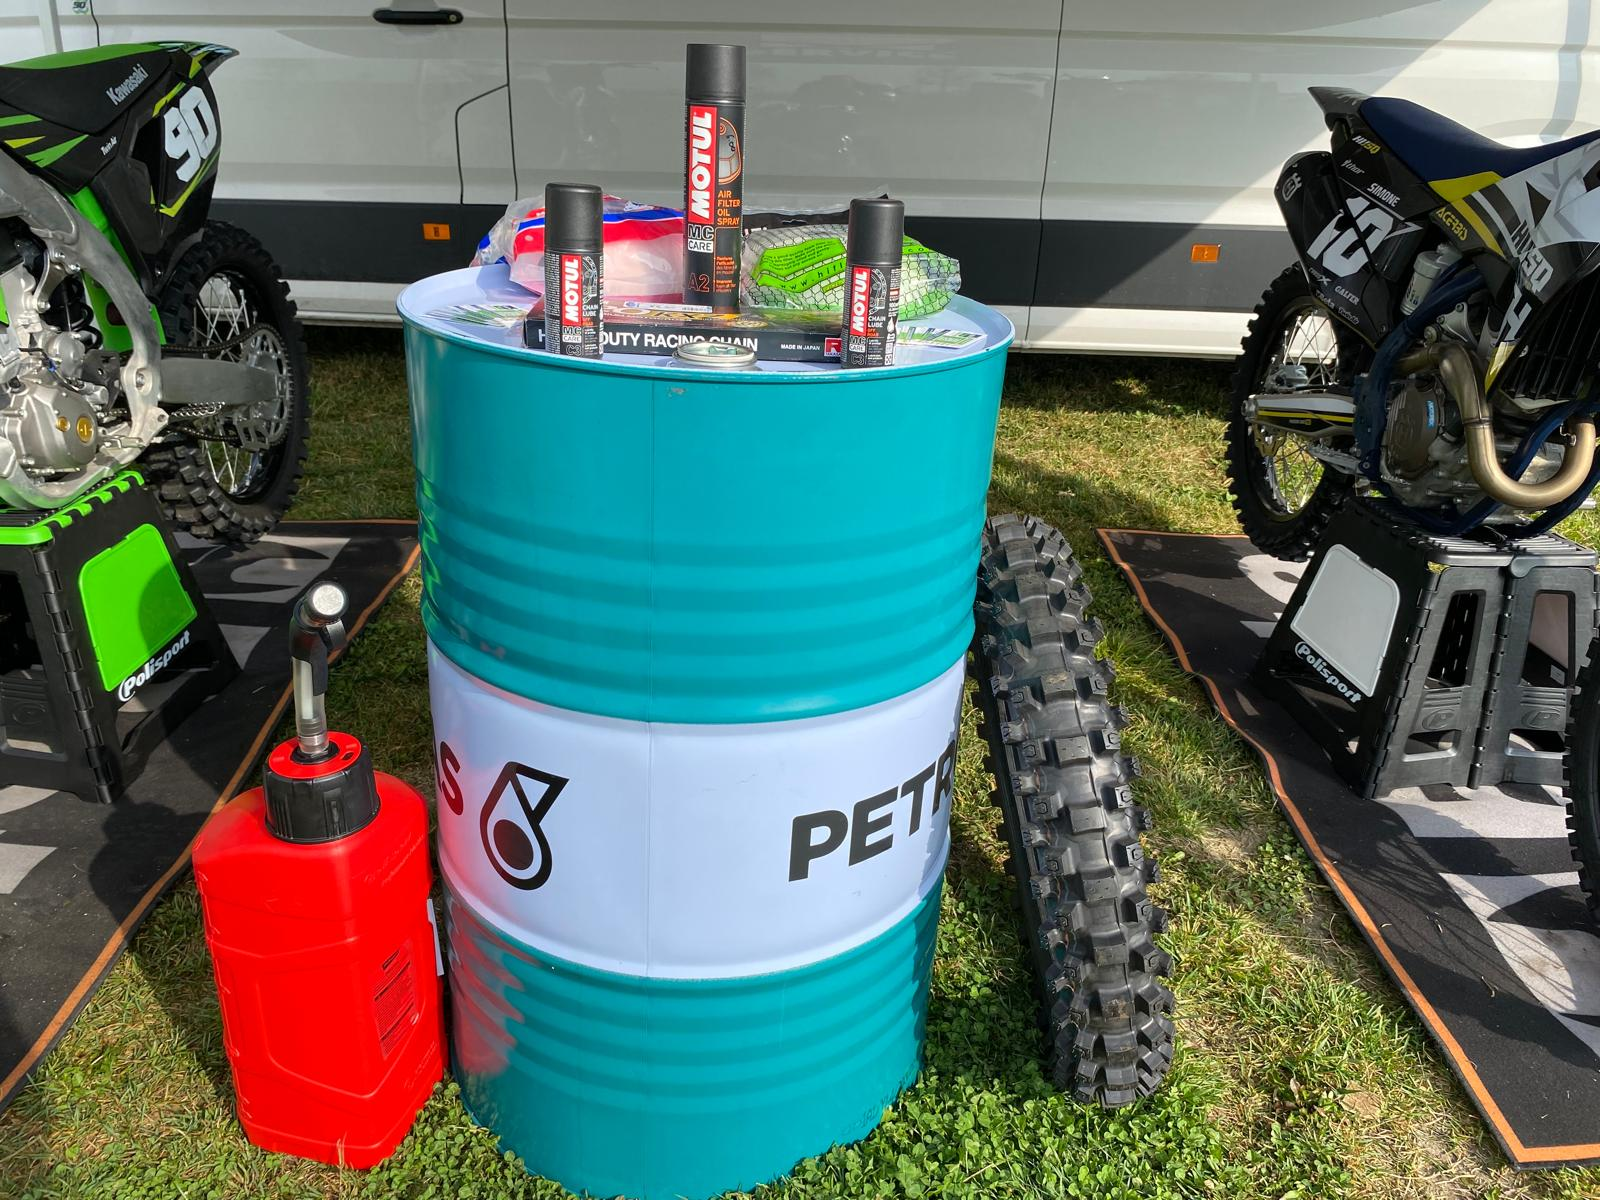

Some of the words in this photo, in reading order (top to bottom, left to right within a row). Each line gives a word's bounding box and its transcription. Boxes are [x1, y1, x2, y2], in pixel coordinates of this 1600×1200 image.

[106, 64, 149, 105] Kawasaki
[163, 86, 218, 182] 90
[691, 112, 712, 219] MOTUL
[717, 190, 732, 198] AIR
[717, 199, 741, 207] FILTER
[1366, 182, 1401, 207] SIMONE
[717, 208, 730, 216] OIL
[717, 217, 740, 226] SPRAY
[687, 224, 714, 240] MC
[1436, 207, 1469, 241] ACERBIS
[688, 241, 712, 251] CARE
[565, 258, 579, 322] MOTUL
[688, 273, 710, 293] A2
[852, 271, 867, 333] MOTUL
[1335, 286, 1360, 305] GALFER
[562, 326, 582, 335] MC
[566, 344, 582, 356] C3
[850, 336, 866, 345] MC
[851, 354, 865, 366] C3
[118, 630, 190, 702] Polisport
[1295, 641, 1361, 703] Polisport
[435, 738, 464, 816] S
